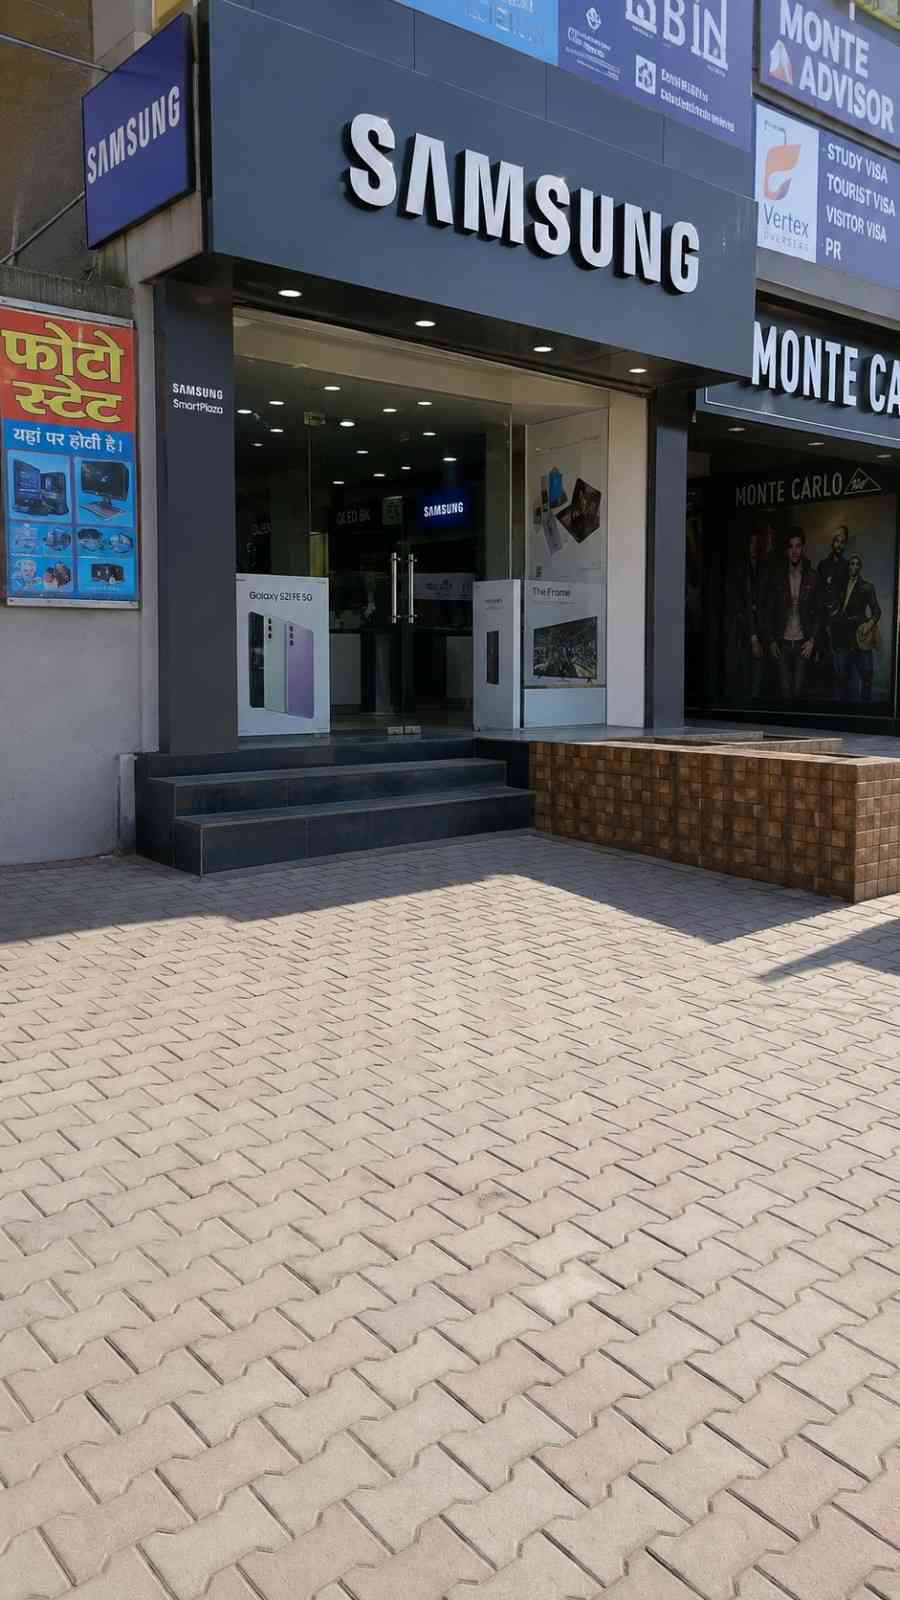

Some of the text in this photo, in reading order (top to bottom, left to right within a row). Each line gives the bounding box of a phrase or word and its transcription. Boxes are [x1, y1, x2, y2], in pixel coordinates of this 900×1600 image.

[781, 0, 869, 79] MONTE
[799, 56, 894, 133] ADVISOR
[87, 86, 180, 184] SAMSUNG
[828, 143, 888, 184] STUDY VISA
[349, 112, 700, 294] SAMSUNG
[827, 172, 896, 217] TOURIST VISA
[763, 203, 809, 239] Vertex
[826, 205, 887, 243] VISITOR VISA
[825, 238, 842, 260] PR
[1, 321, 124, 383] फोटो
[752, 320, 858, 406] MONTE
[12, 374, 122, 423] स्टेट
[172, 382, 223, 400] SAMSUNG
[172, 398, 223, 414] SmartPlaza
[13, 427, 41, 445] यहां
[46, 432, 65, 446] पर
[68, 431, 100, 451] होती
[735, 480, 785, 507] MONTE
[791, 471, 843, 500] CARLO
[423, 502, 464, 518] SAMSUNG
[249, 591, 279, 602] Galaxy
